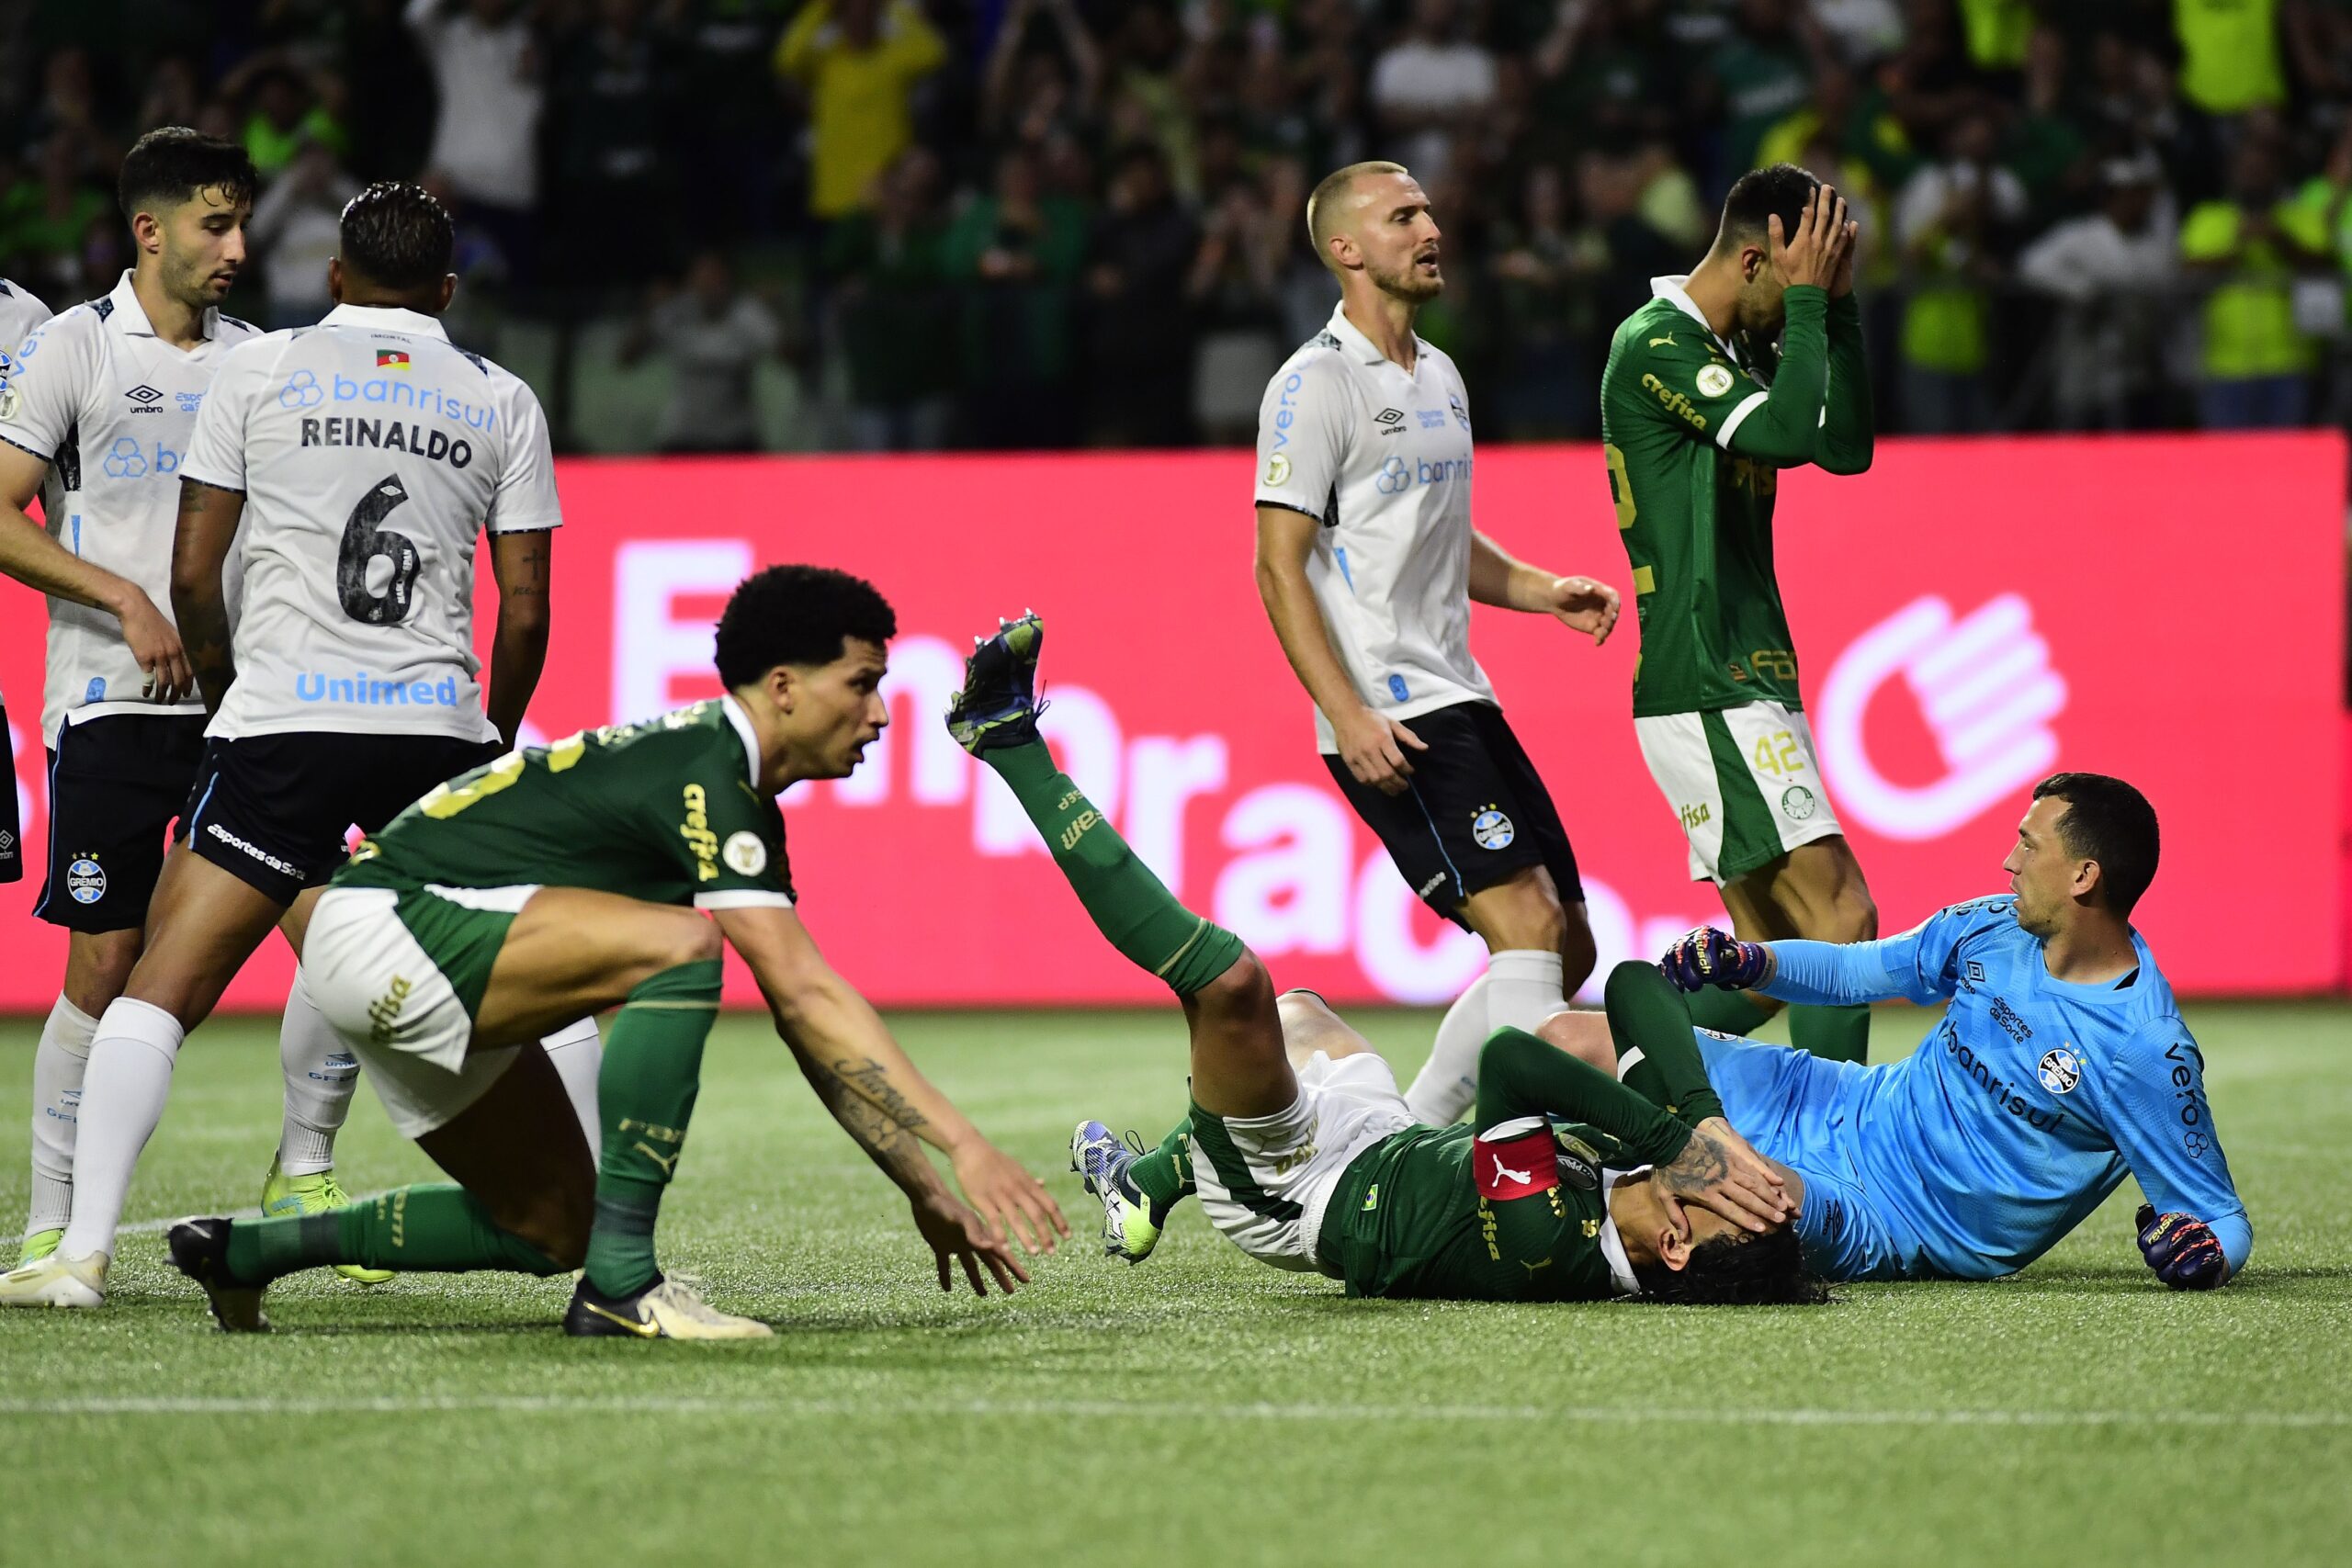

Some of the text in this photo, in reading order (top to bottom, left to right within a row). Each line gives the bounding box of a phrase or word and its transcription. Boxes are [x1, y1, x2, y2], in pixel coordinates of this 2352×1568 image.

[130, 406, 164, 414] umbro
[334, 373, 496, 433] banrisul
[1273, 371, 1304, 449] vero
[1642, 372, 1707, 432] crefisa
[301, 417, 472, 468] REINALDO
[1417, 453, 1473, 485] banri
[336, 472, 421, 625] 6
[295, 671, 458, 707] Unimed
[1754, 730, 1804, 775] 42
[1678, 802, 1712, 829] fisa
[1993, 997, 2034, 1039] Esportes
[1999, 1016, 2025, 1045] Sorte
[1945, 1021, 2065, 1134] banrisul
[2165, 1043, 2205, 1127] vero
